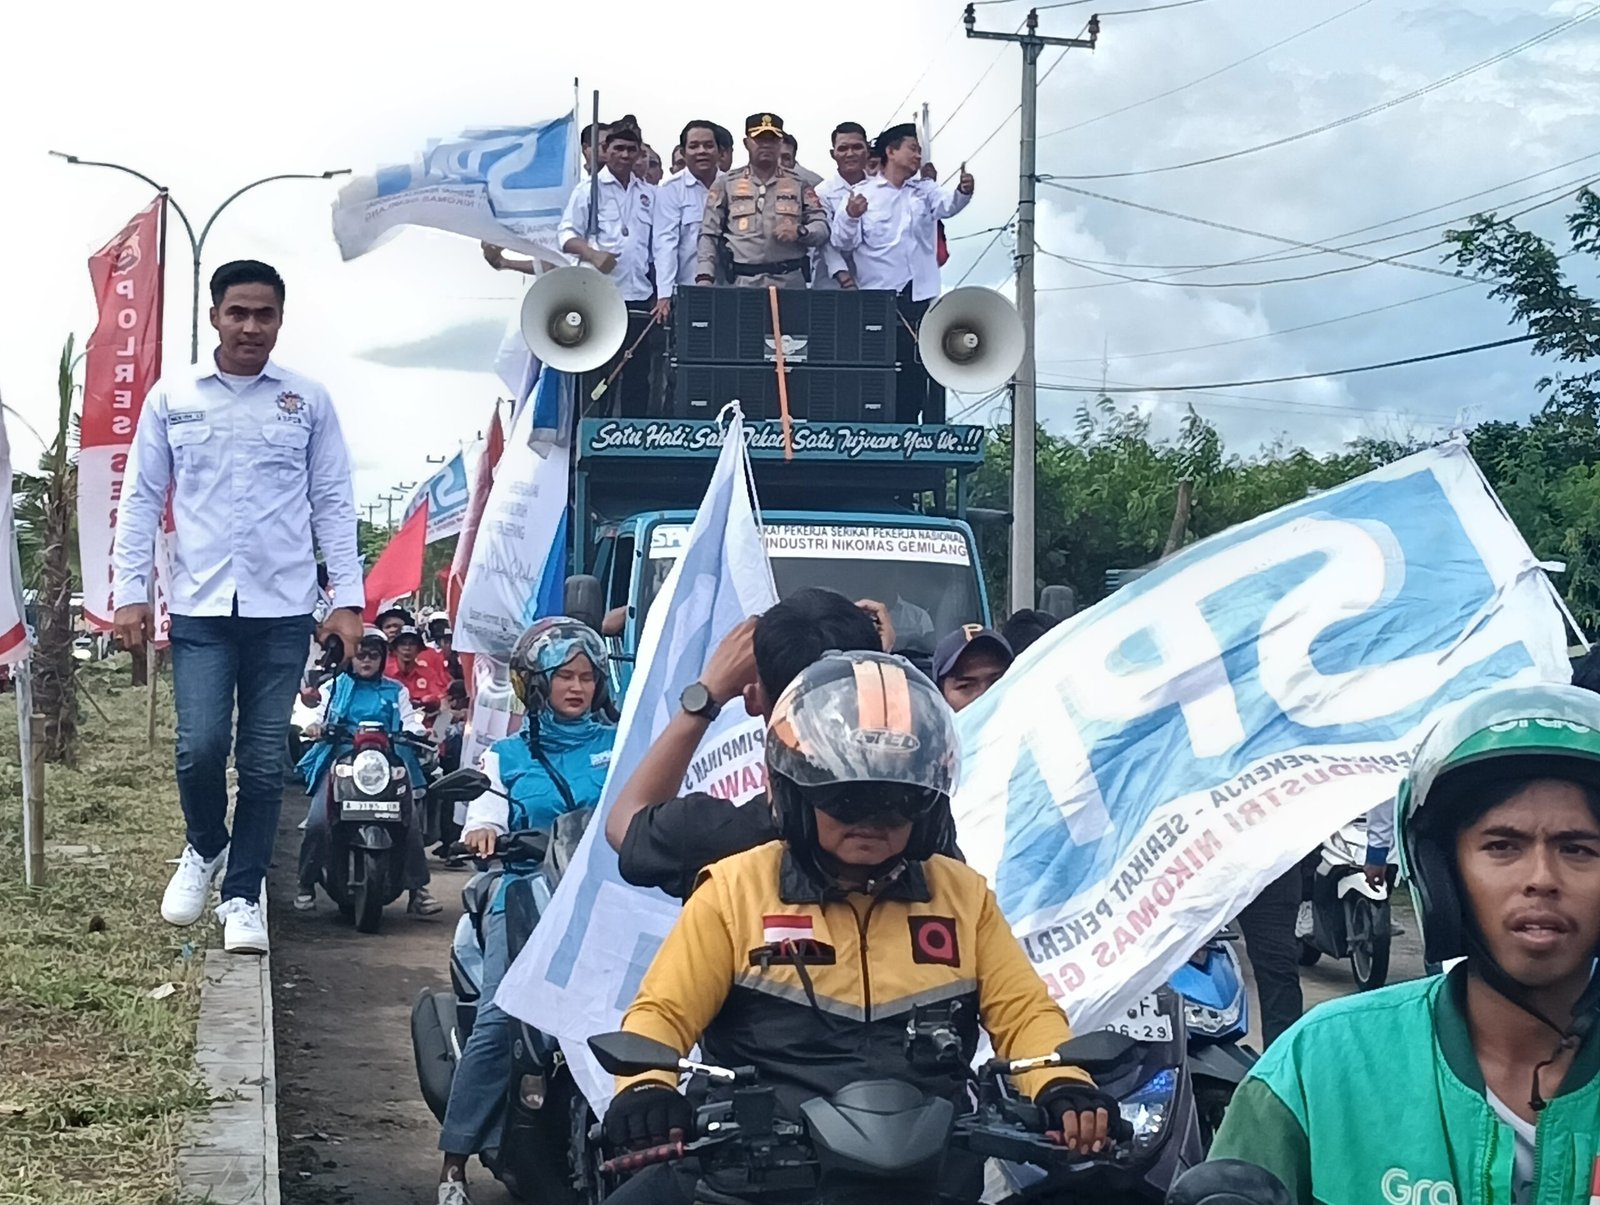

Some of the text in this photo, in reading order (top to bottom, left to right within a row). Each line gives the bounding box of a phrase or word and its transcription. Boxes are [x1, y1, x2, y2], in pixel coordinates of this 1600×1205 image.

[592, 423, 643, 449] Satu
[690, 427, 727, 448] Sat
[792, 429, 835, 449] Satu
[837, 429, 901, 456] Tujuan
[784, 525, 827, 537] PEKERJA
[831, 526, 870, 539] SERIKAT
[873, 528, 916, 540] PEKERJA
[918, 530, 964, 544] NASIONAL
[765, 537, 967, 556] INDUSTRI NIKOMAS GEMILANG
